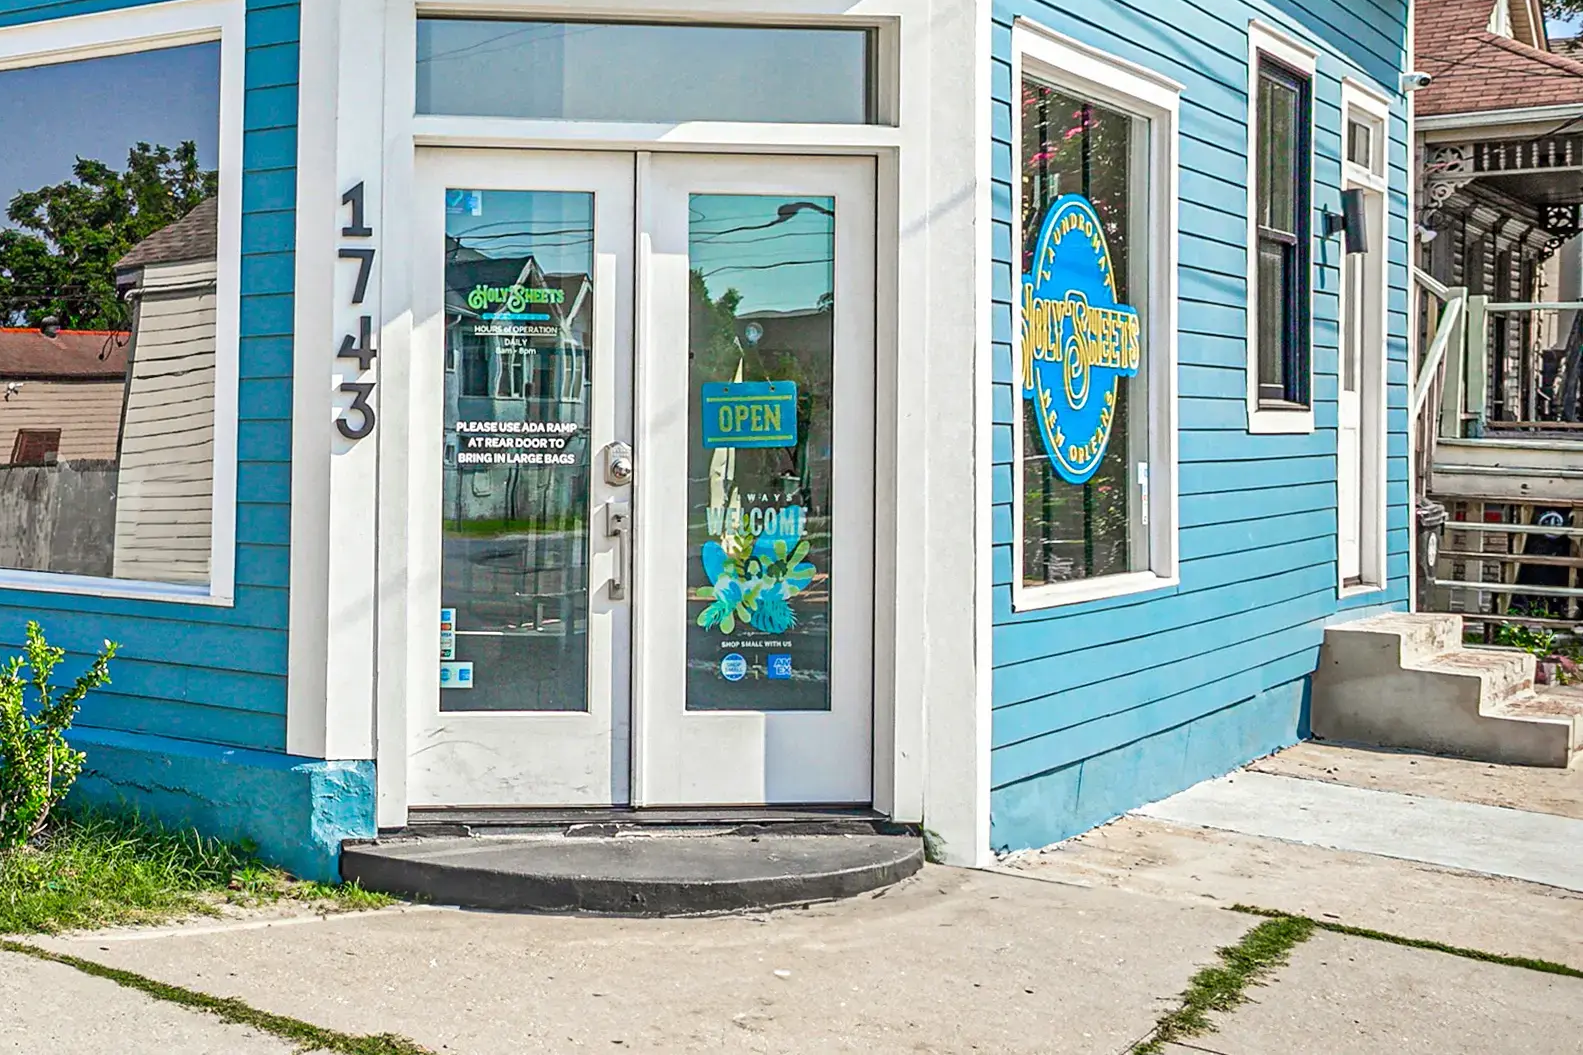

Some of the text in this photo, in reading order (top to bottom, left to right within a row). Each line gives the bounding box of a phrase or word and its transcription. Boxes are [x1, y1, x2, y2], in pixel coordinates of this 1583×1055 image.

[1041, 212, 1112, 286] LAUNDROMAT
[336, 180, 377, 440] 1743
[468, 284, 565, 313] HOLY SHEETS
[474, 325, 558, 334] HOURS of OPERATION
[504, 338, 528, 346] DAILY
[518, 348, 537, 356] 8pm
[1064, 289, 1140, 410] SHEETS
[456, 421, 578, 433] PLEASE USE ADA RAMP
[718, 404, 782, 433] OPEN
[1042, 388, 1114, 464] NEW ORLEANS
[468, 437, 565, 448] AT REAR DOOR TO
[458, 452, 575, 464] BRING IN LARGE BAGS
[706, 507, 808, 536] WELCOME
